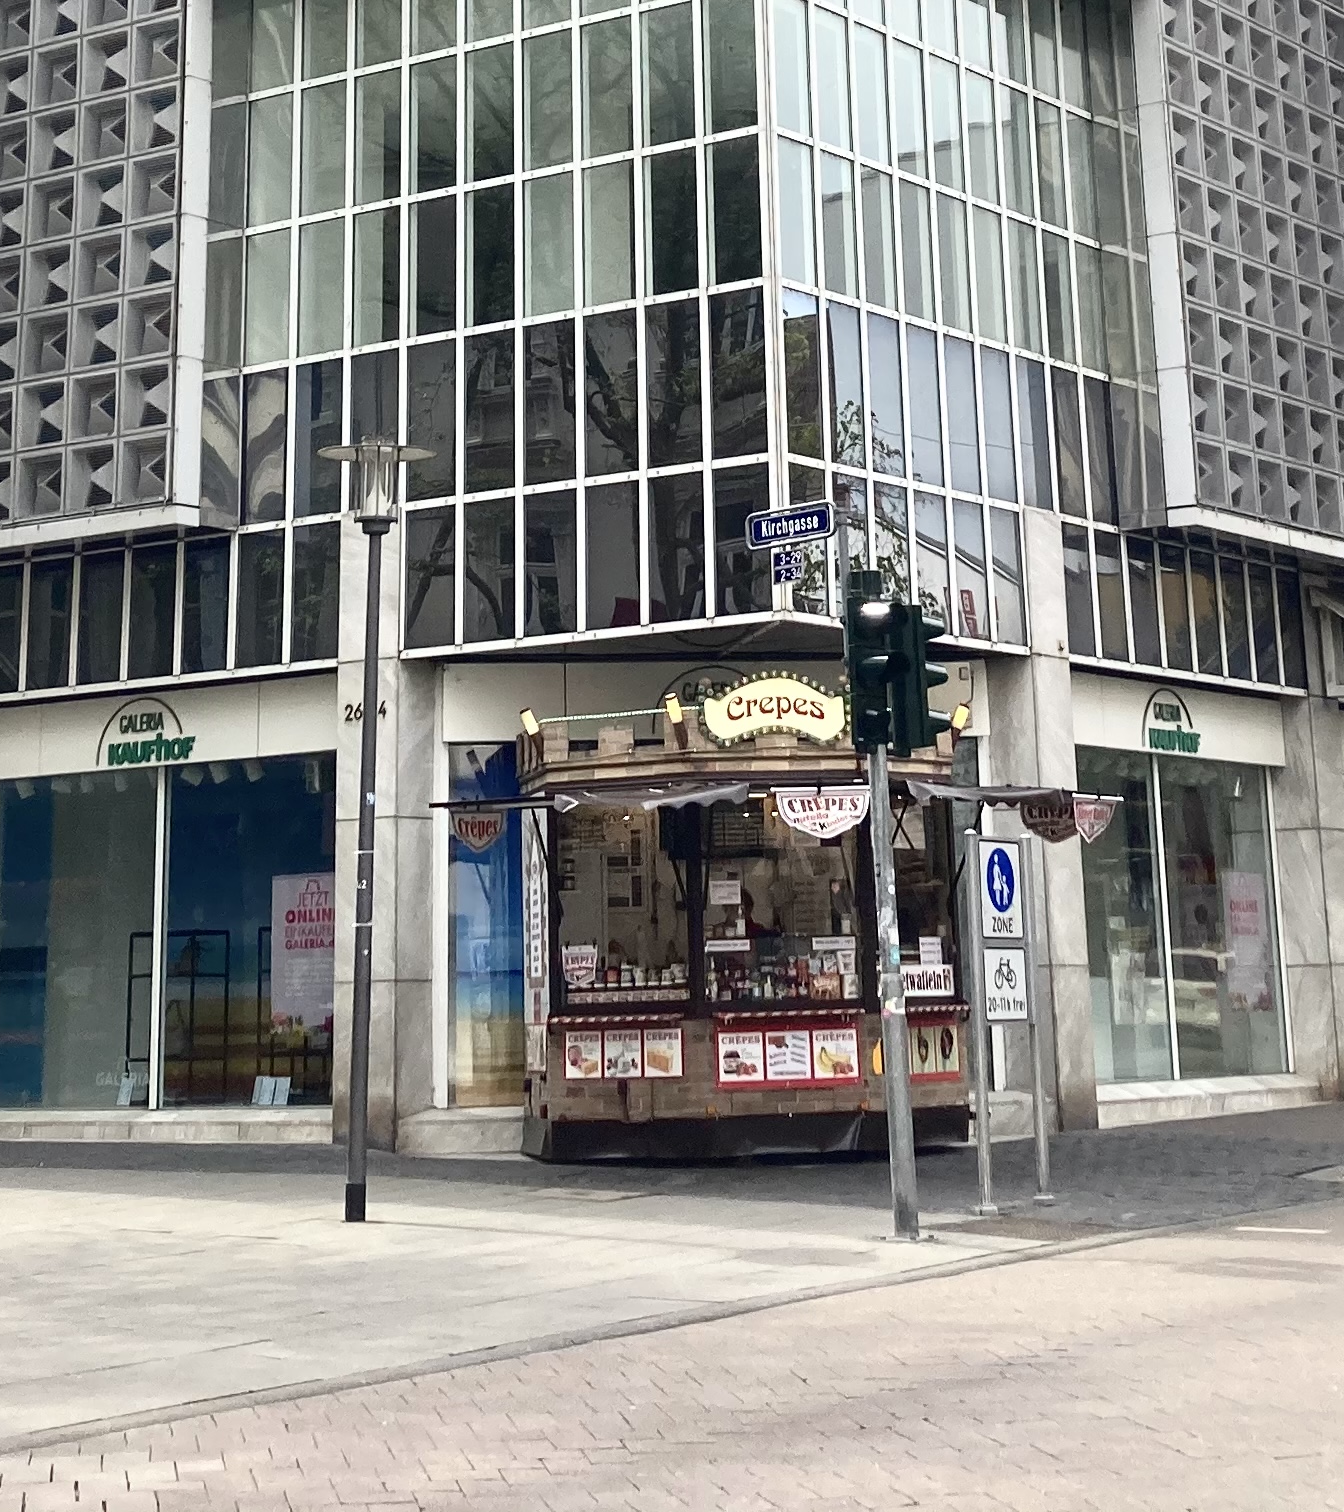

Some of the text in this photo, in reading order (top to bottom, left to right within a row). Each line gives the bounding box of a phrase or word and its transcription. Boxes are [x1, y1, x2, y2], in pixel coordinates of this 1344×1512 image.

[760, 514, 819, 538] Kirchgasse
[779, 550, 802, 566] 3-29
[726, 696, 825, 721] Crepes
[119, 712, 164, 735] GALERIA
[457, 816, 499, 837] Crêpes
[297, 891, 329, 908] JETZT
[285, 908, 335, 924] ONLIN
[991, 916, 1014, 934] ZONE
